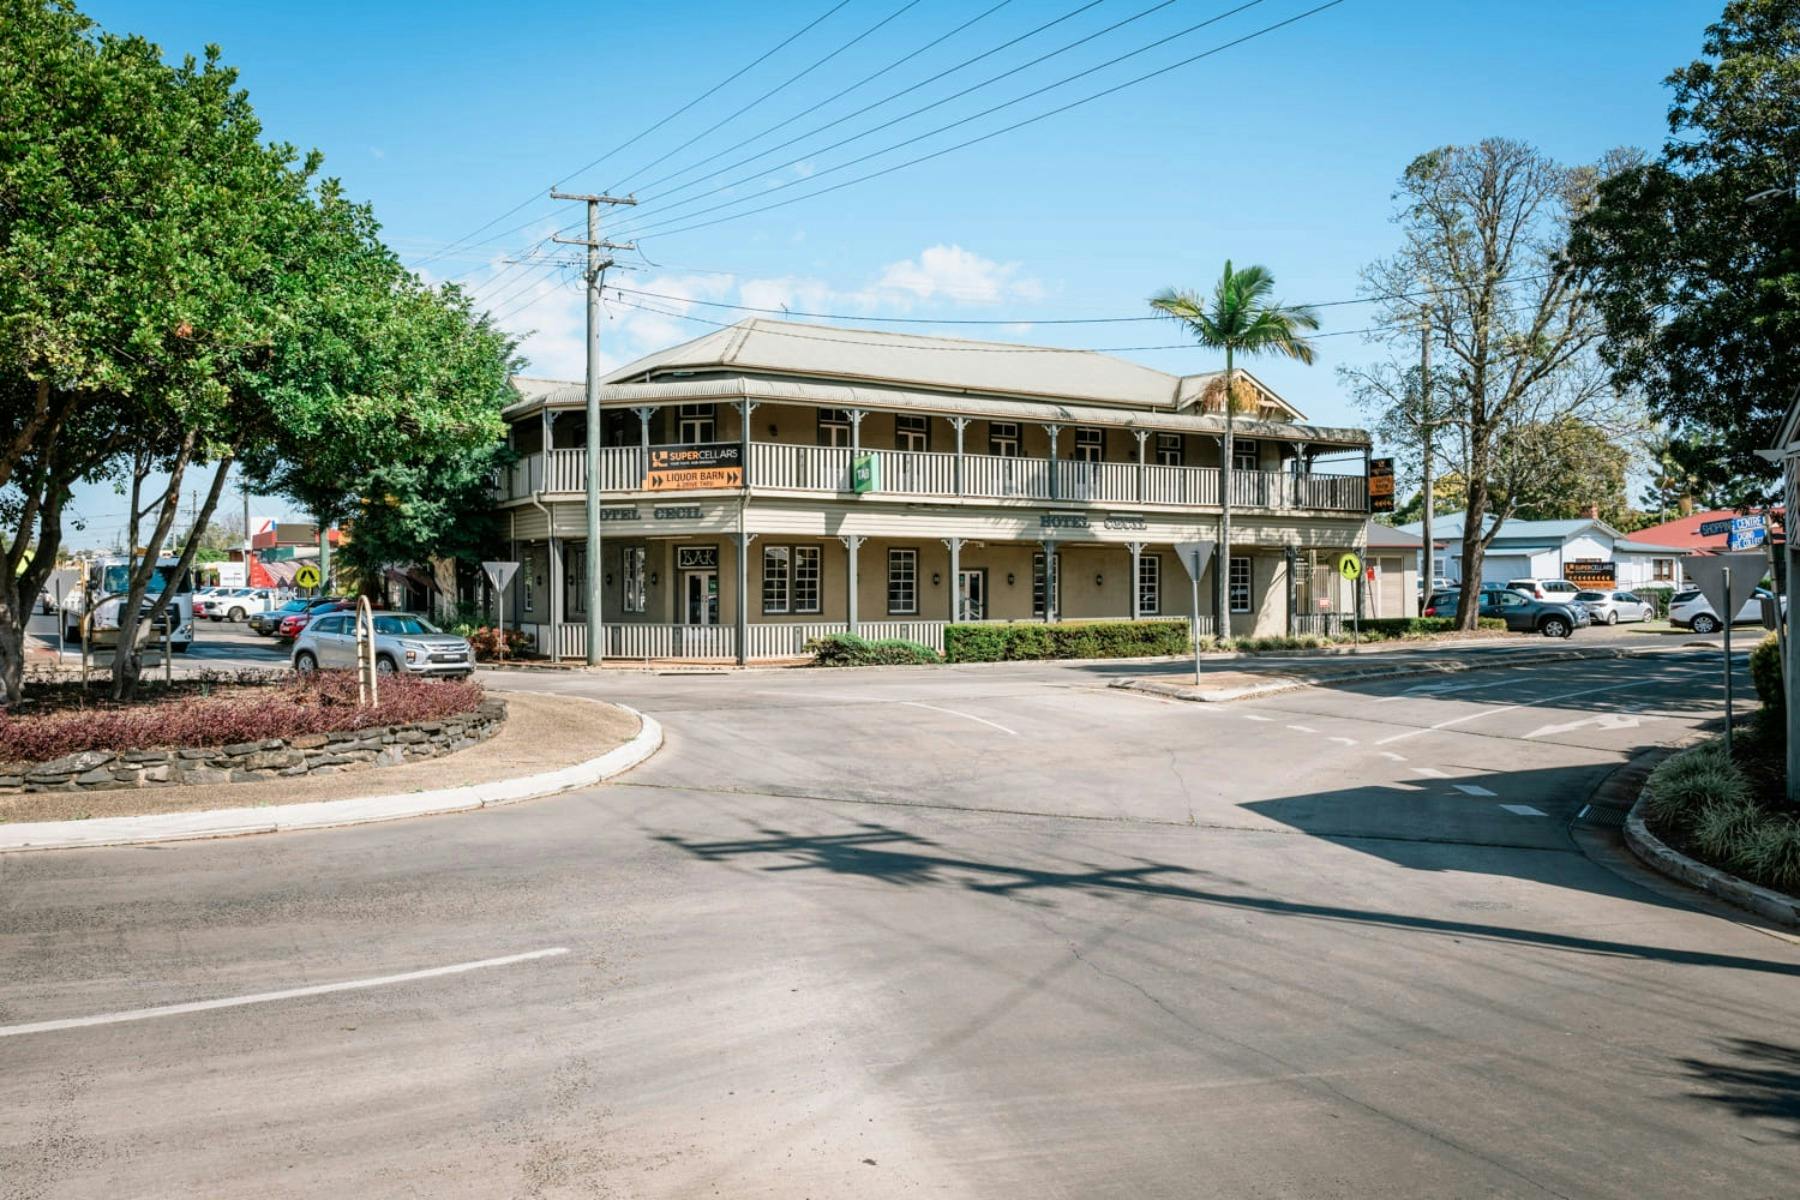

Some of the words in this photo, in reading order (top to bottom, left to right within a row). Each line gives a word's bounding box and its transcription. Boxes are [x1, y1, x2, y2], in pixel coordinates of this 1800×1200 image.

[670, 449, 738, 461] SUPERCELLARS
[666, 472, 697, 482] LIQUOR
[700, 471, 724, 481] BARN
[857, 468, 870, 480] TAB
[599, 508, 641, 520] OTEL
[654, 507, 704, 519] CECIL
[1040, 515, 1091, 528] HOTEL
[1737, 516, 1761, 528] CENTRE
[682, 550, 715, 565] BAR
